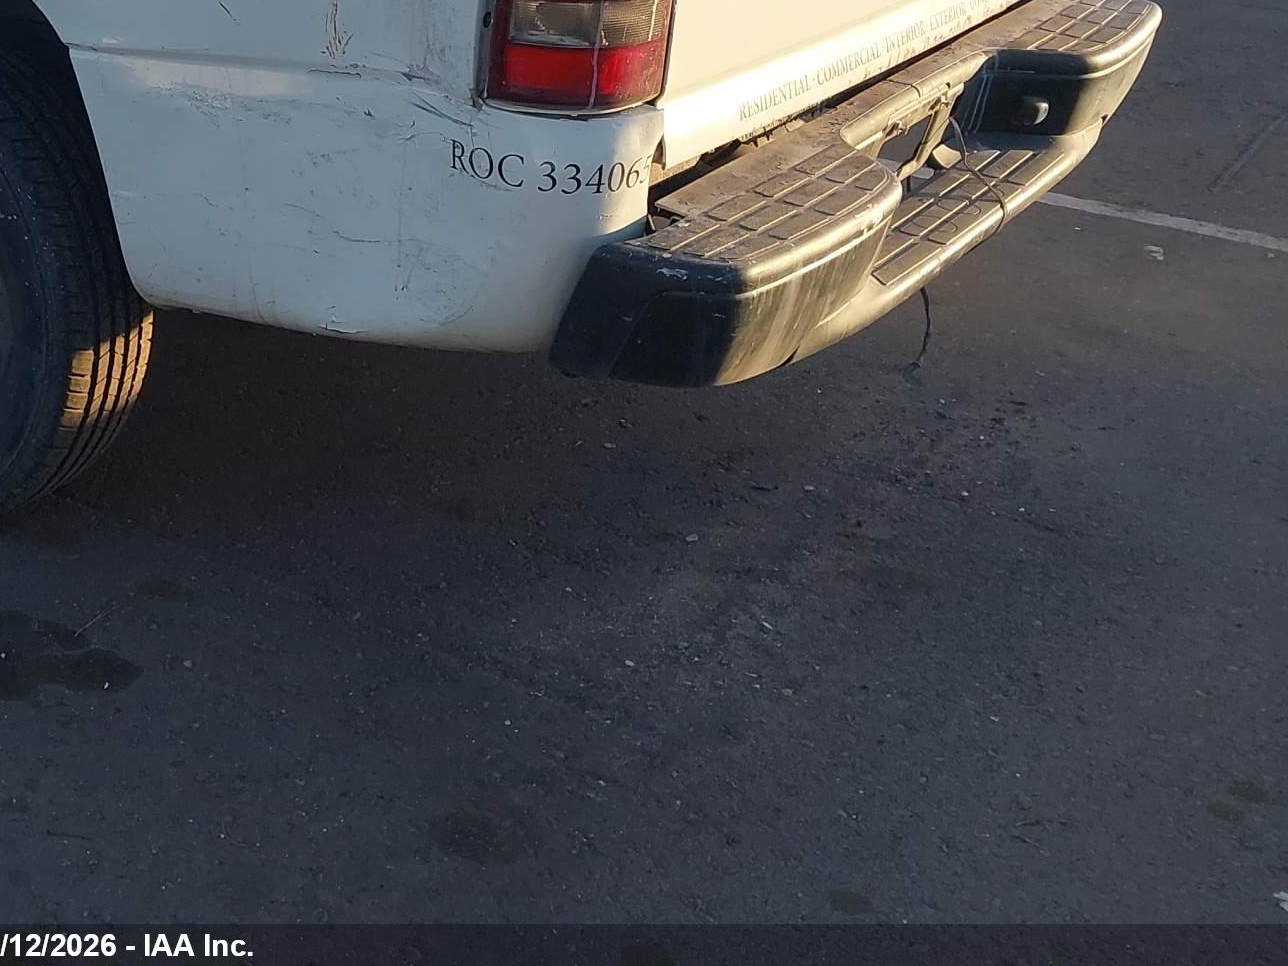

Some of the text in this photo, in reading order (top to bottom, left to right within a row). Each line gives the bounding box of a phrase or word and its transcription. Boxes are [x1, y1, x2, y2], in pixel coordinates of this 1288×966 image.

[738, 73, 812, 121] RESIDENTIAL
[816, 41, 881, 86] COMMERCIAL
[885, 20, 926, 54] INTERIOR
[929, 1, 967, 30] EXTERIOR
[450, 138, 525, 187] ROC
